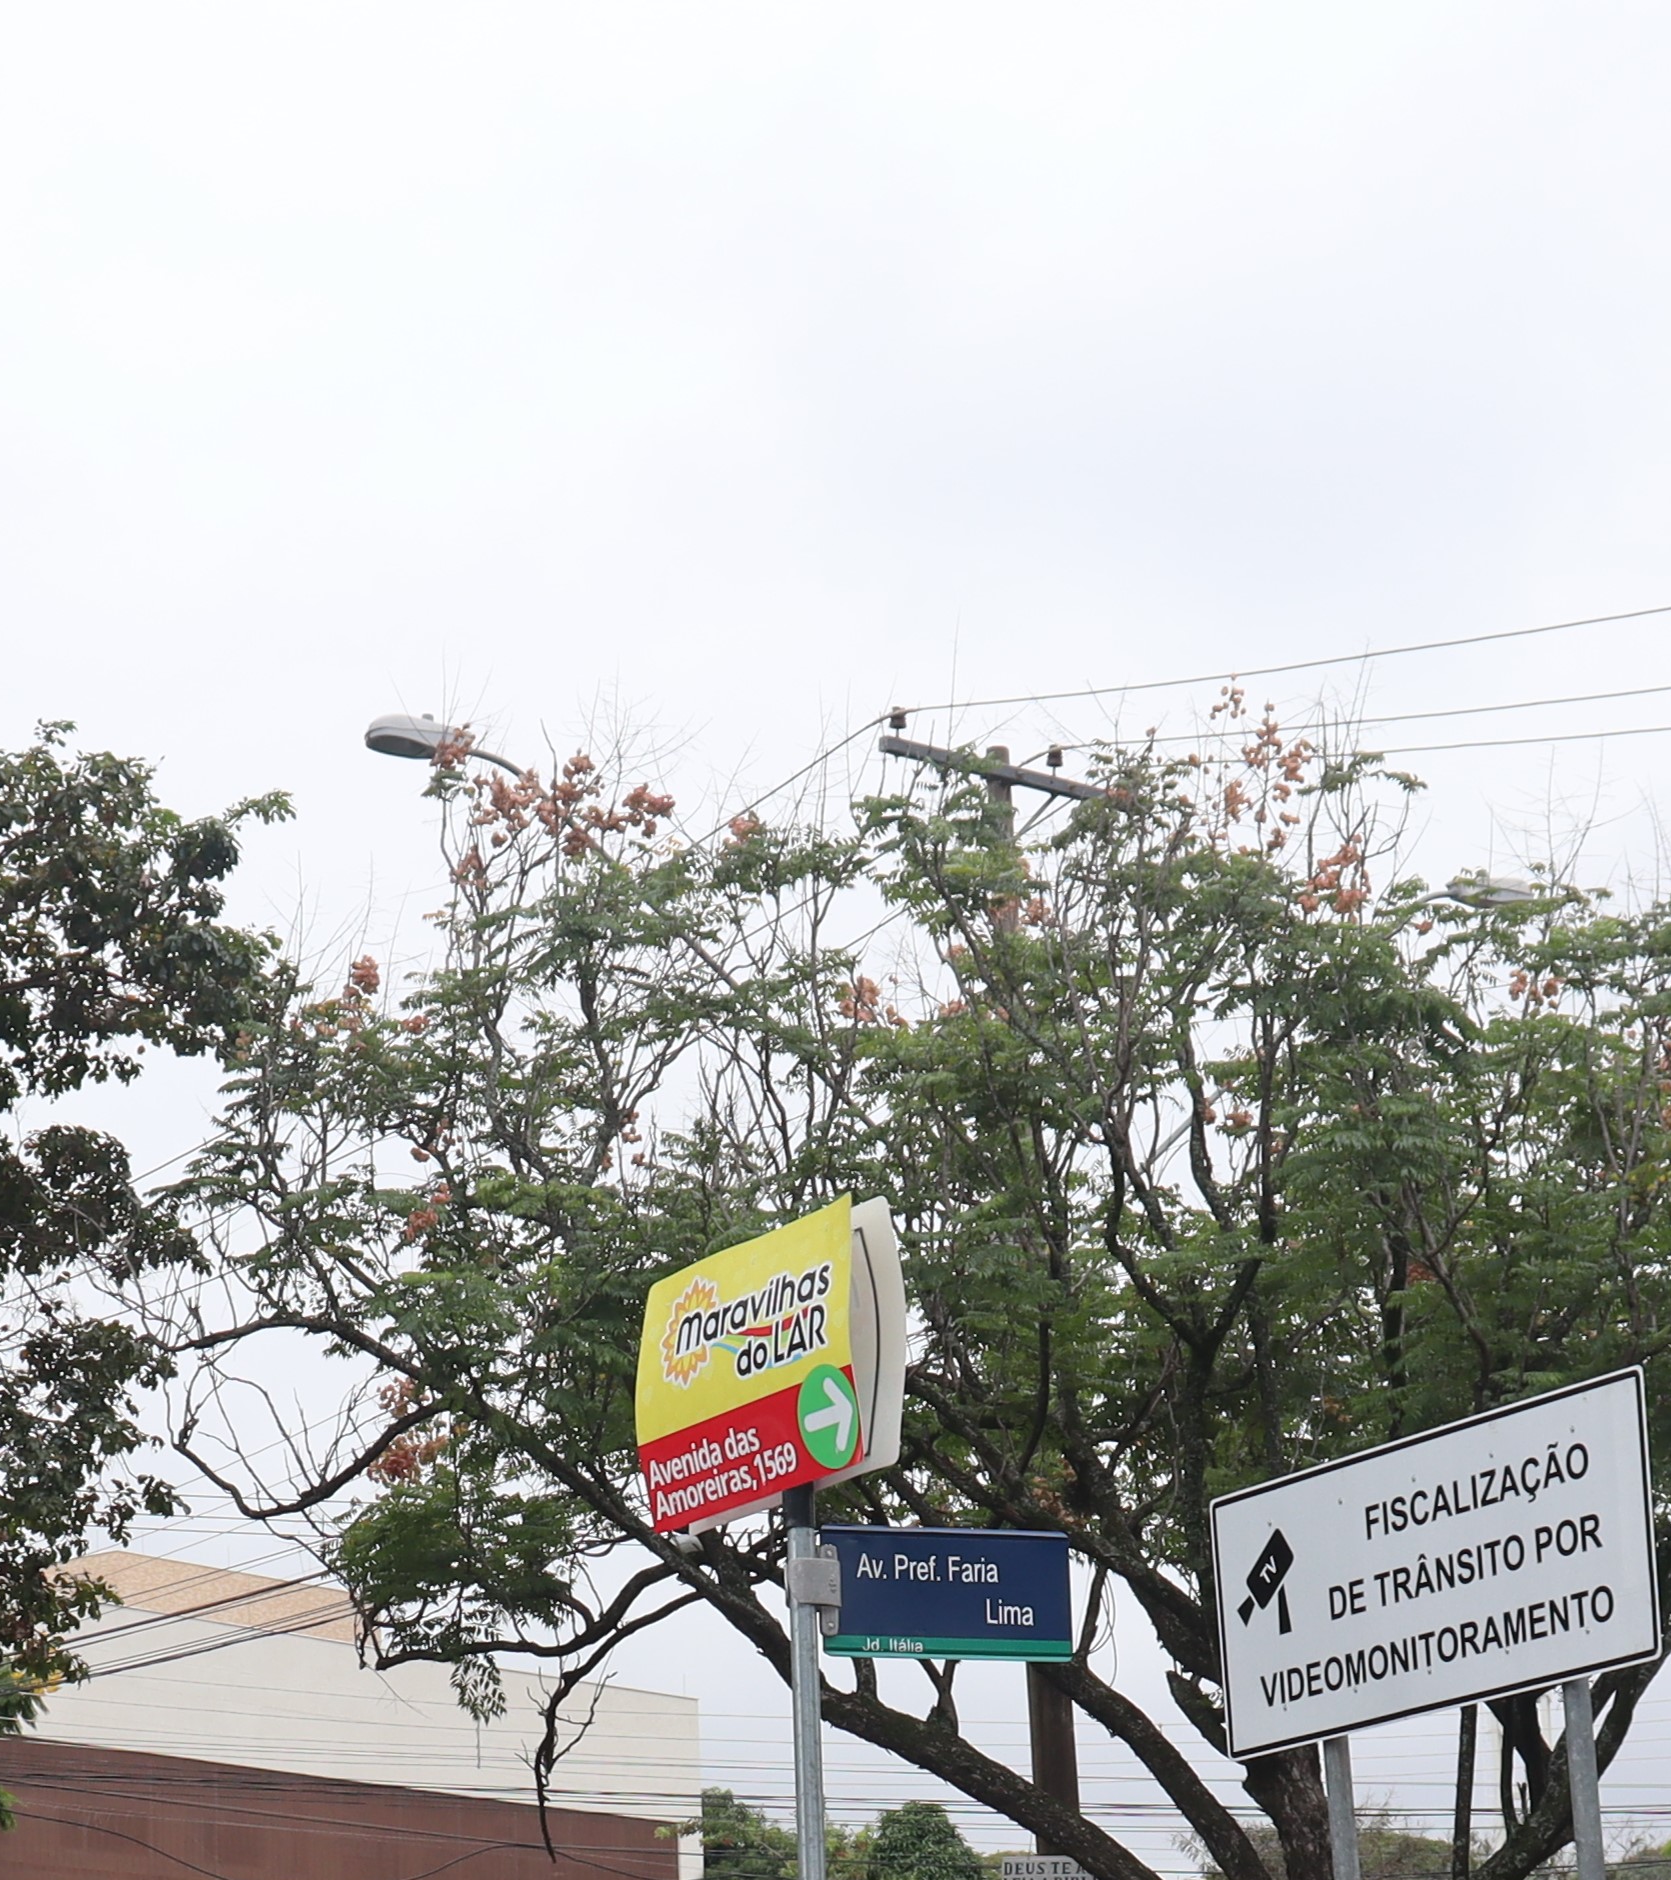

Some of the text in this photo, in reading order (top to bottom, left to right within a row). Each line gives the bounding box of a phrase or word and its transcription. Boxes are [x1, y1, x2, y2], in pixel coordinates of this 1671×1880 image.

[736, 1304, 826, 1376] do LAR
[649, 1427, 760, 1490] Avenida das
[1364, 1442, 1590, 1540] FISCALIZAÇÃO
[856, 1552, 999, 1584] Av. Pref. Faria
[1259, 1555, 1277, 1584] TV
[1328, 1513, 1603, 1621] DE TRÂNSITO POR
[985, 1598, 1035, 1627] Lima
[861, 1637, 924, 1653] Jd. Itália
[1260, 1584, 1615, 1708] VIDEOMONITORAMENTO
[1003, 1861, 1047, 1876] DEUS
[1050, 1861, 1072, 1875] TE
